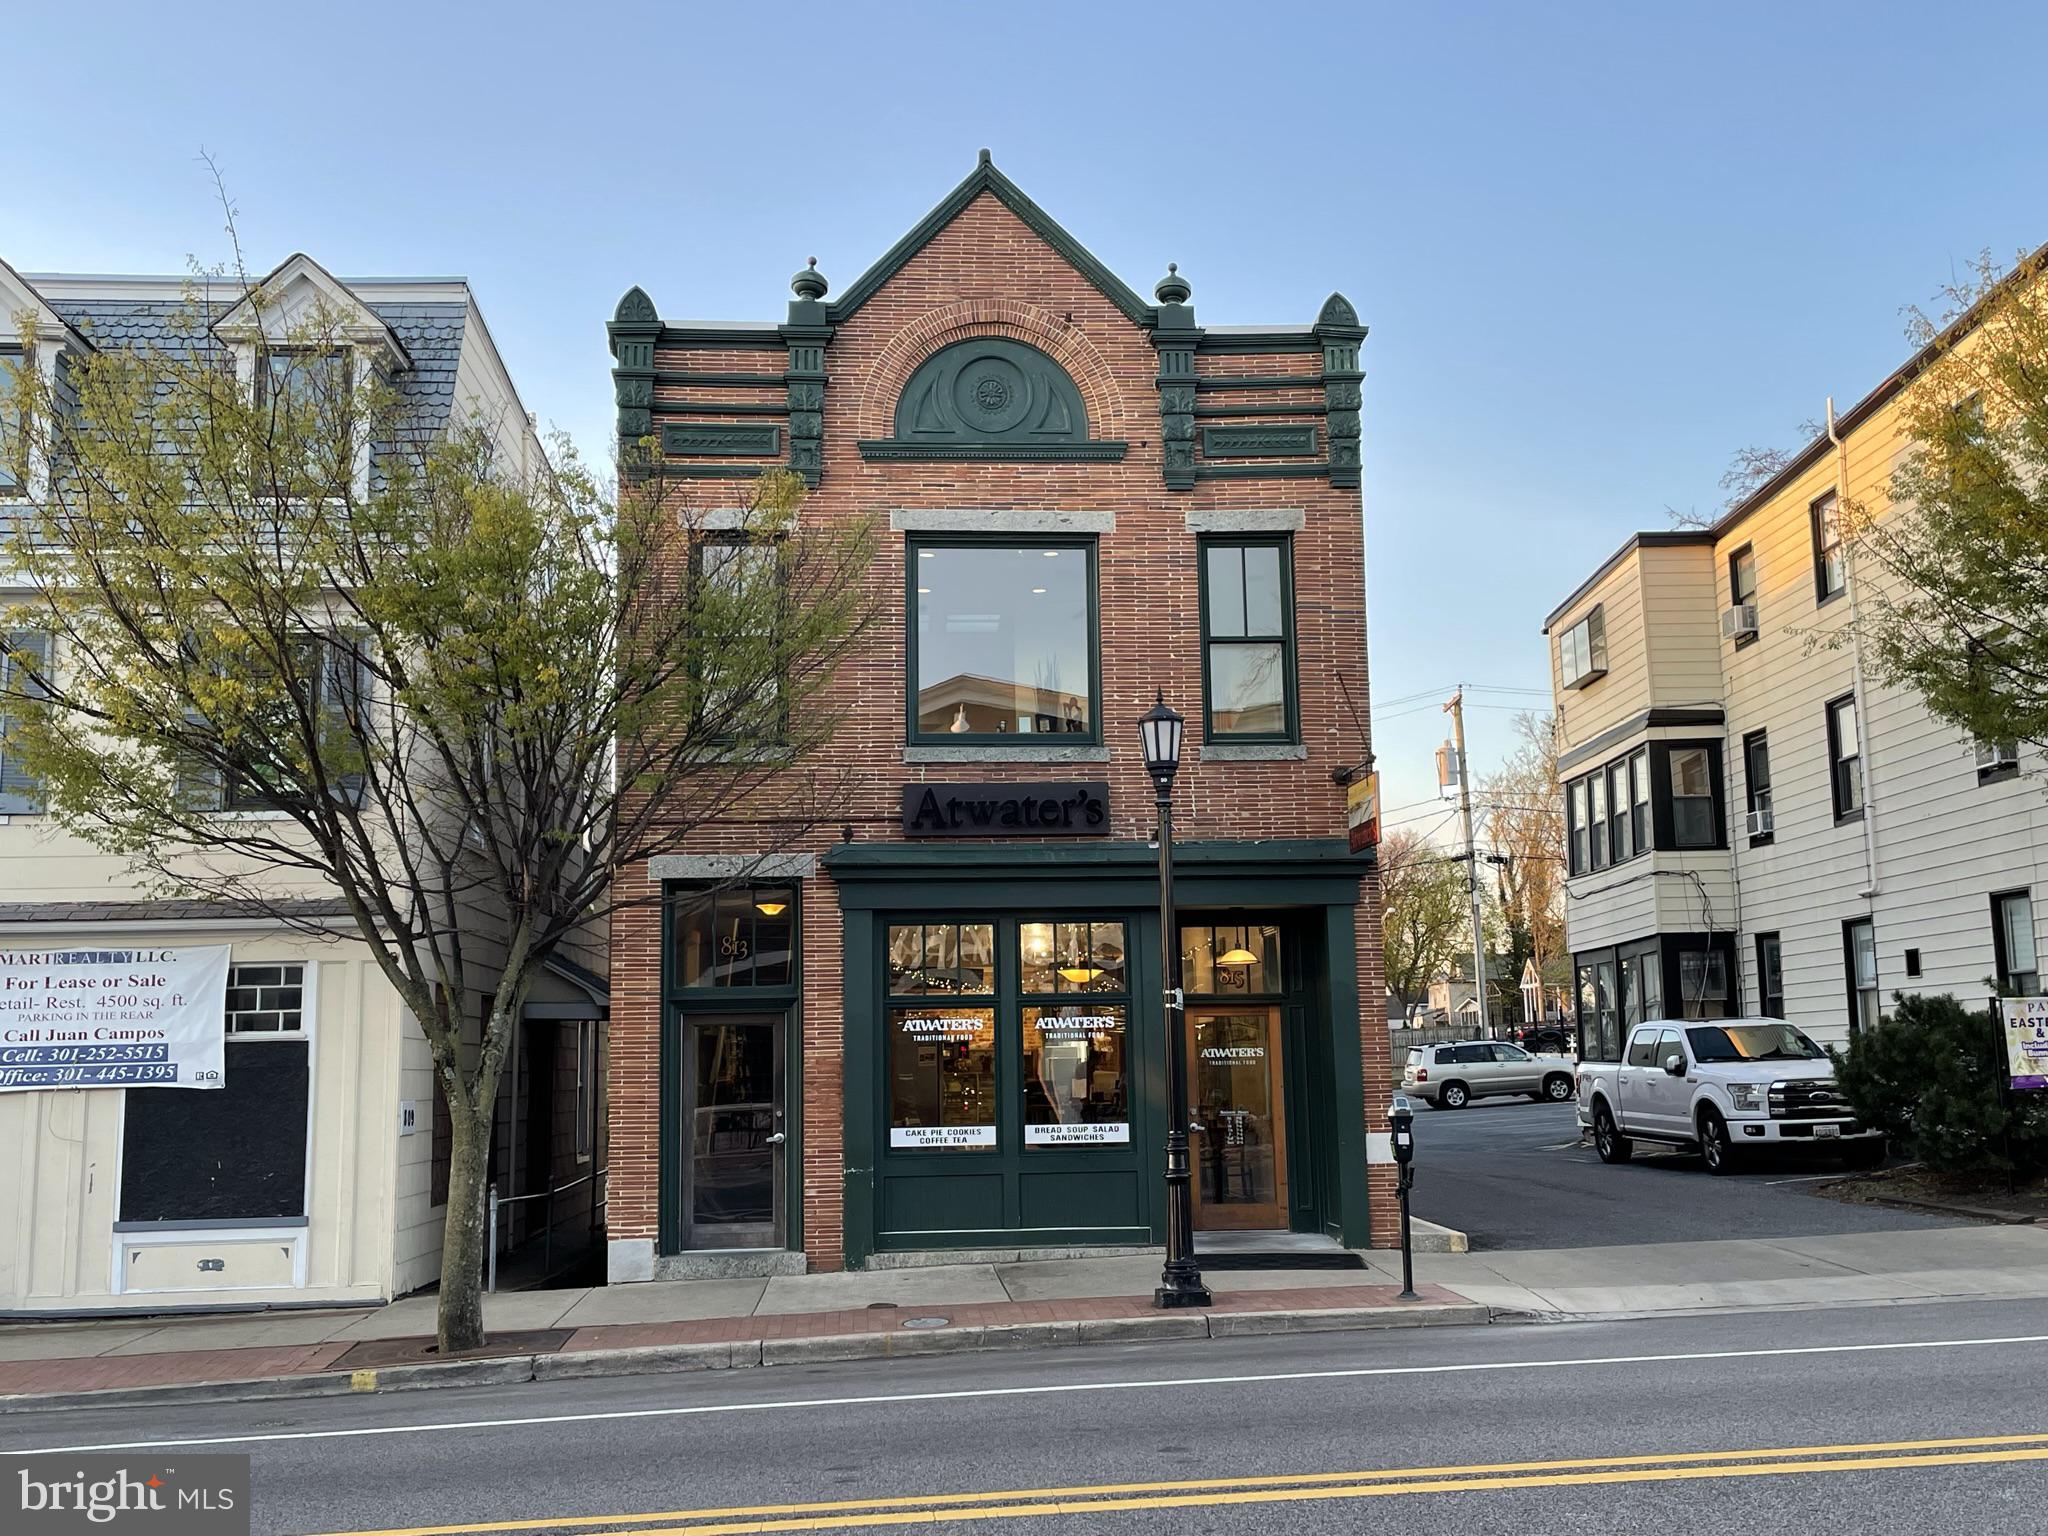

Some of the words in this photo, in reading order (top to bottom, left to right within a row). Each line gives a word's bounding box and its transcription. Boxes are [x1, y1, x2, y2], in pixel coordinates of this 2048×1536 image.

[911, 787, 1104, 829] Atwater's
[721, 936, 748, 959] 813
[136, 951, 177, 963] LLC.
[6, 977, 38, 990] For
[45, 976, 97, 990] Lease
[102, 978, 123, 988] or
[128, 974, 166, 987] Sale
[1220, 968, 1244, 989] 815
[47, 996, 86, 1009] Rest.
[96, 995, 138, 1007] 4500
[143, 997, 164, 1009] sq.
[172, 994, 188, 1006] ft.
[18, 1012, 73, 1022] PARKING
[76, 1012, 89, 1021] IN
[92, 1011, 116, 1020] THE
[120, 1010, 153, 1020] REAR
[902, 1018, 984, 1032] ATWATER'S
[1035, 1016, 1115, 1029] ATWATER'S
[4, 1029, 40, 1042] Call
[45, 1029, 88, 1041] Juan
[94, 1027, 165, 1042] Campos
[1088, 1031, 1105, 1039] FOOD
[2036, 1028, 2045, 1038] &
[2, 1049, 43, 1062] Cell:
[47, 1046, 164, 1061] 301-252-5515
[1200, 1047, 1264, 1058] ATWATER'S
[905, 1129, 927, 1137] CAKE
[947, 1128, 982, 1136] COOKIES
[1035, 1126, 1062, 1134] BREAD
[1067, 1126, 1089, 1134] SOUP
[1092, 1125, 1120, 1133] SALAD
[920, 1137, 949, 1145] COFFEE
[952, 1136, 968, 1144] TEA
[1050, 1133, 1105, 1141] SANDWICHES
